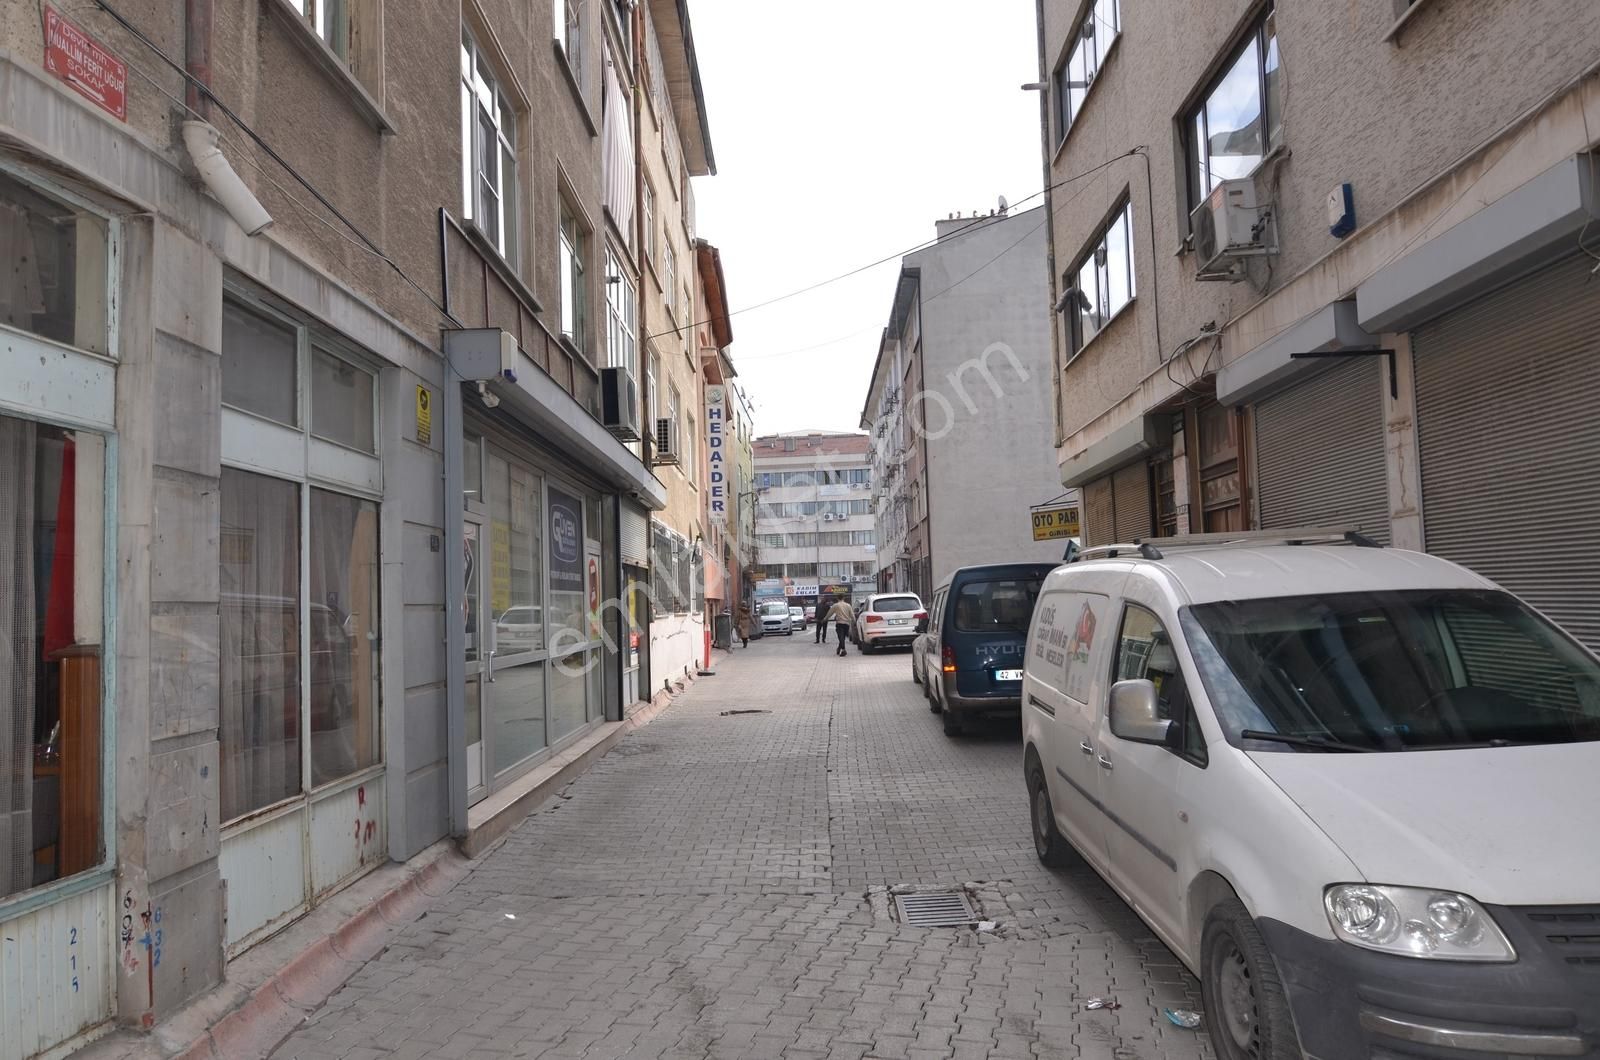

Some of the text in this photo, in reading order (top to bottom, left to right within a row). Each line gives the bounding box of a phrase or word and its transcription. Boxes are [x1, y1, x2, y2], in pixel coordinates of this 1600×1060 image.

[66, 59, 105, 93] SOKAK
[1034, 513, 1053, 527] OTO
[1000, 671, 1009, 679] 42
